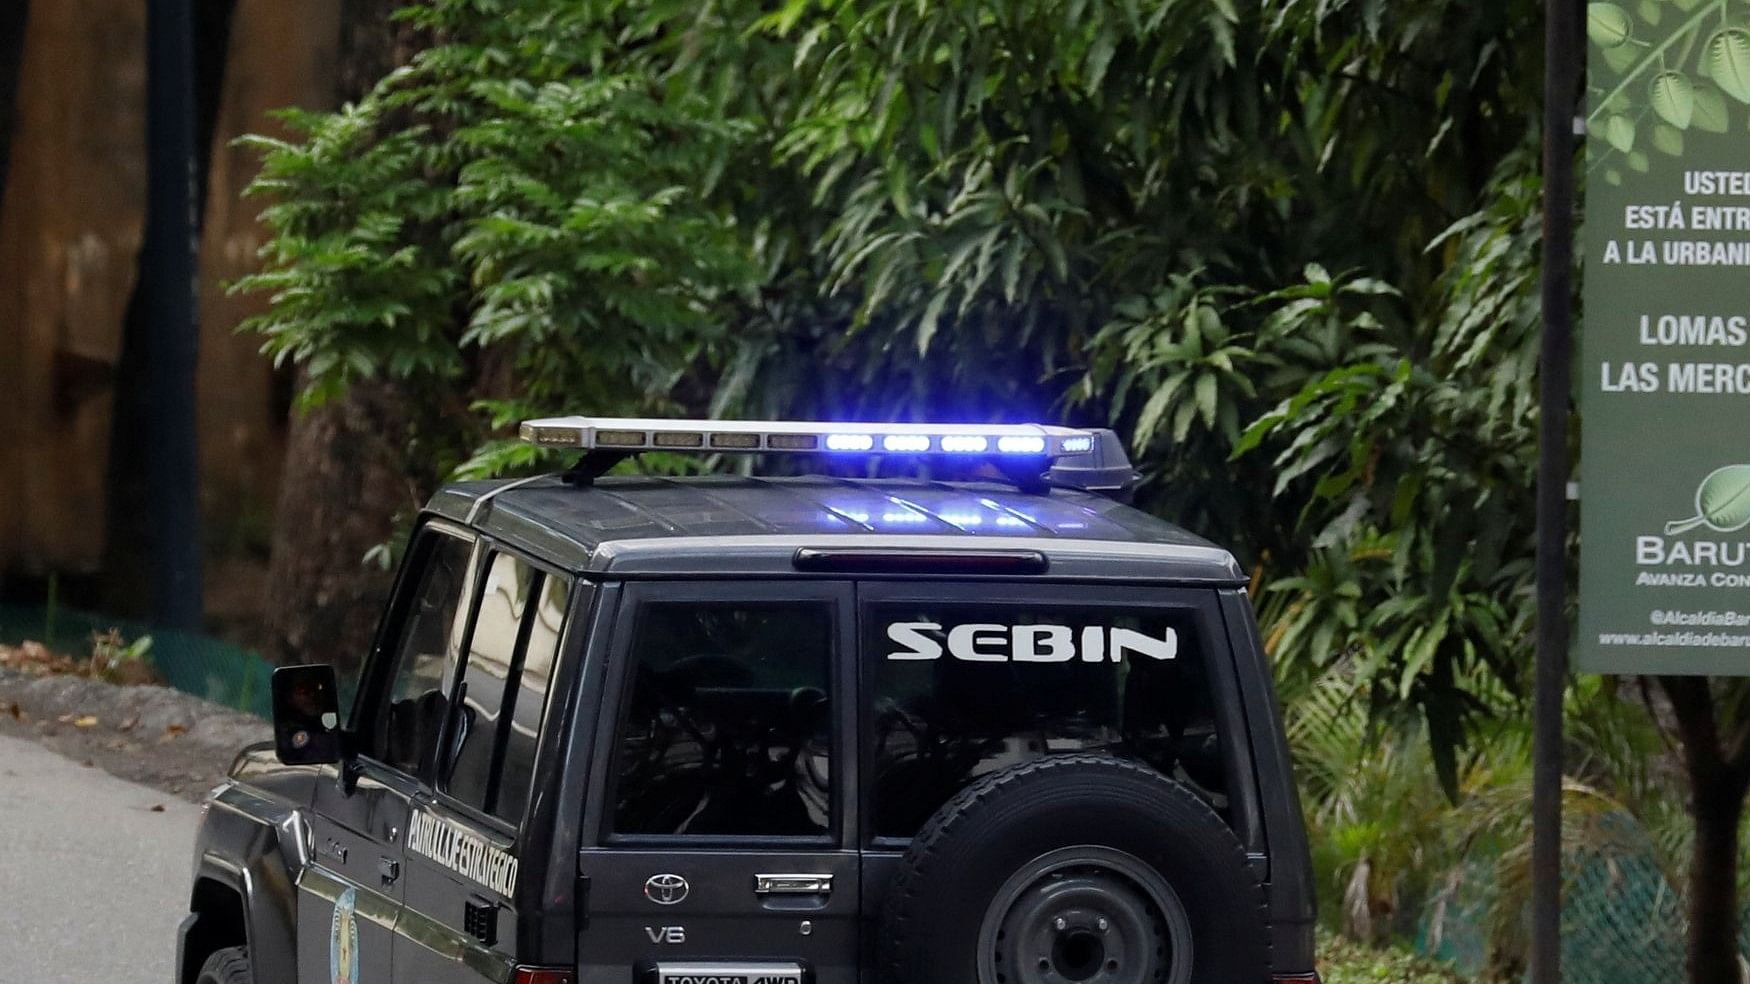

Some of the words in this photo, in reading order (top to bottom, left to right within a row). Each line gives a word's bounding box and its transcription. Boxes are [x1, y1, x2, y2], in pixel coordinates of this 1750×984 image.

[1625, 201, 1685, 229] ESTÁ
[1603, 240, 1621, 264] A
[1627, 240, 1656, 264] LA
[1639, 315, 1747, 347] LOMAS
[1601, 362, 1659, 392] LAS
[1636, 571, 1707, 587] AVANZA
[886, 621, 1178, 663] SEBIN
[408, 809, 462, 871] PATRULLAJE
[459, 835, 519, 899] ESTRATEGICO
[644, 926, 686, 943] V6
